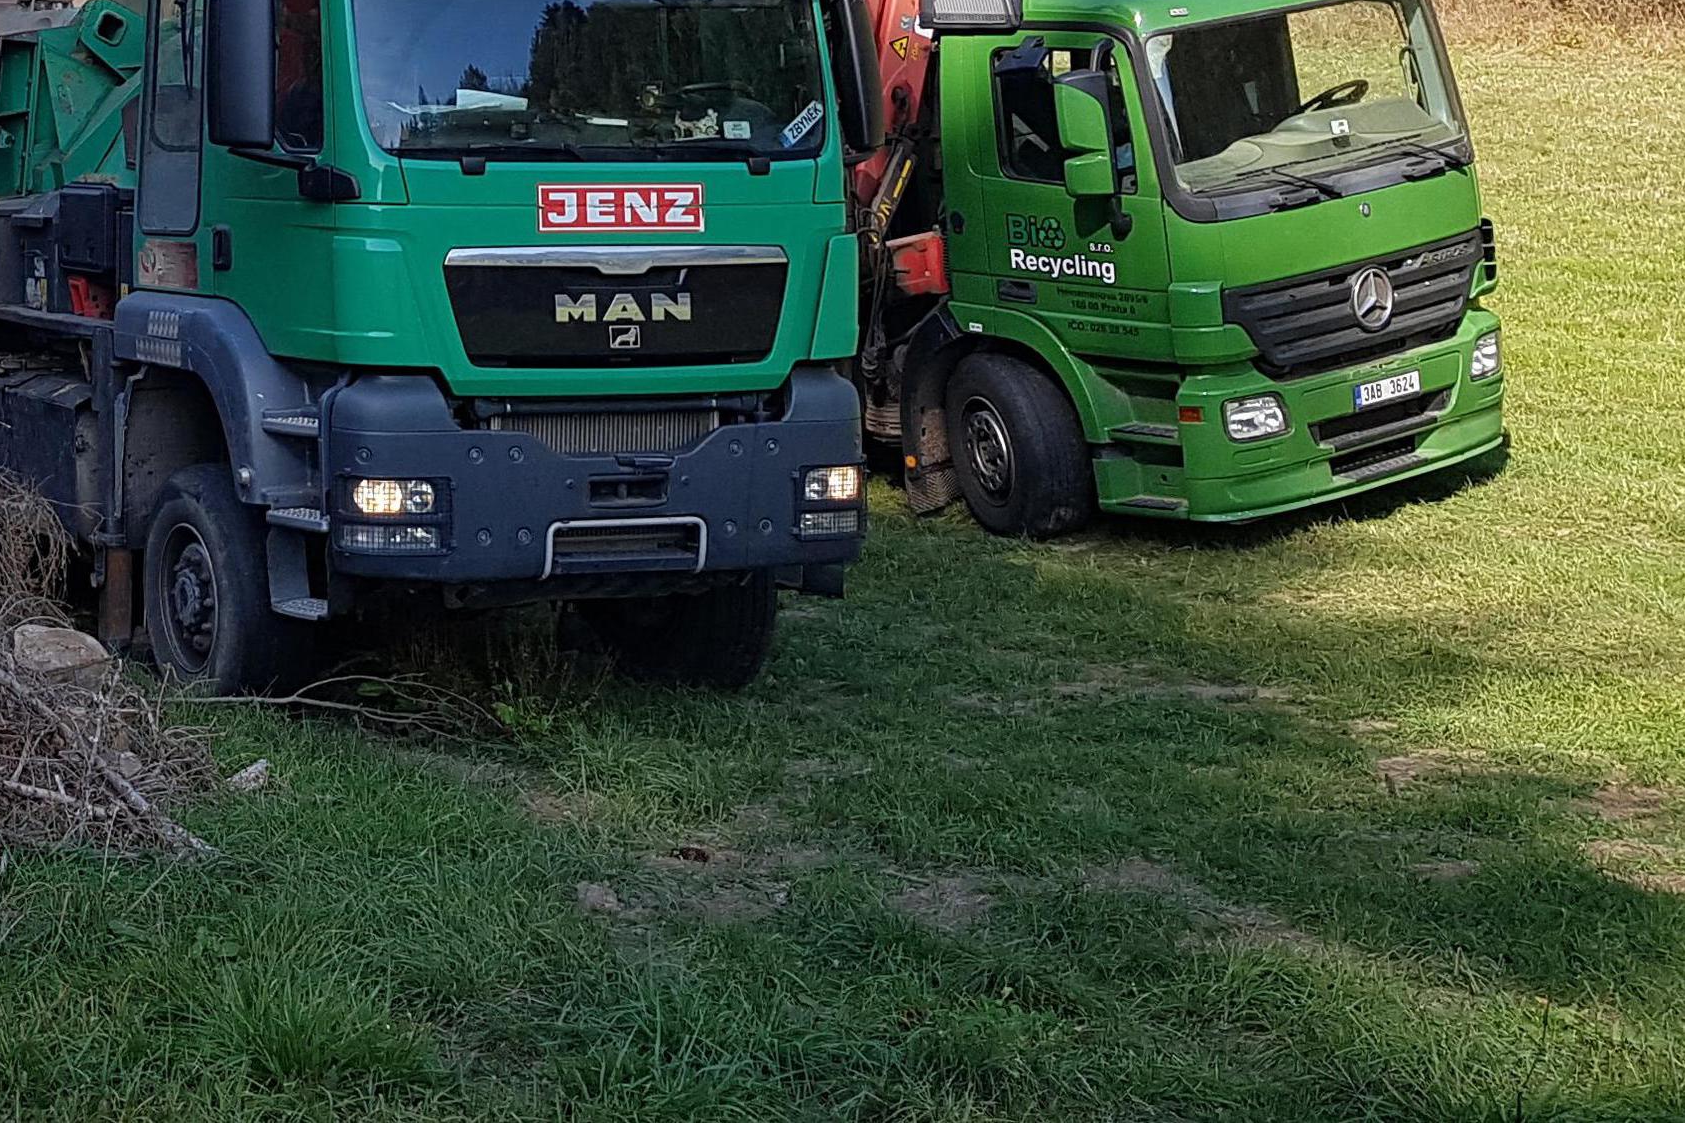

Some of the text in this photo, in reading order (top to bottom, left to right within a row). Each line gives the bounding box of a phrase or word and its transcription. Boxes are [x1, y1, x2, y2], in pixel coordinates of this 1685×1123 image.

[547, 192, 695, 223] JENZ
[1089, 242, 1114, 253] s.r.o.
[1010, 248, 1115, 284] Recycling
[555, 293, 691, 322] MAN
[1364, 374, 1415, 402] 3AB 3624
